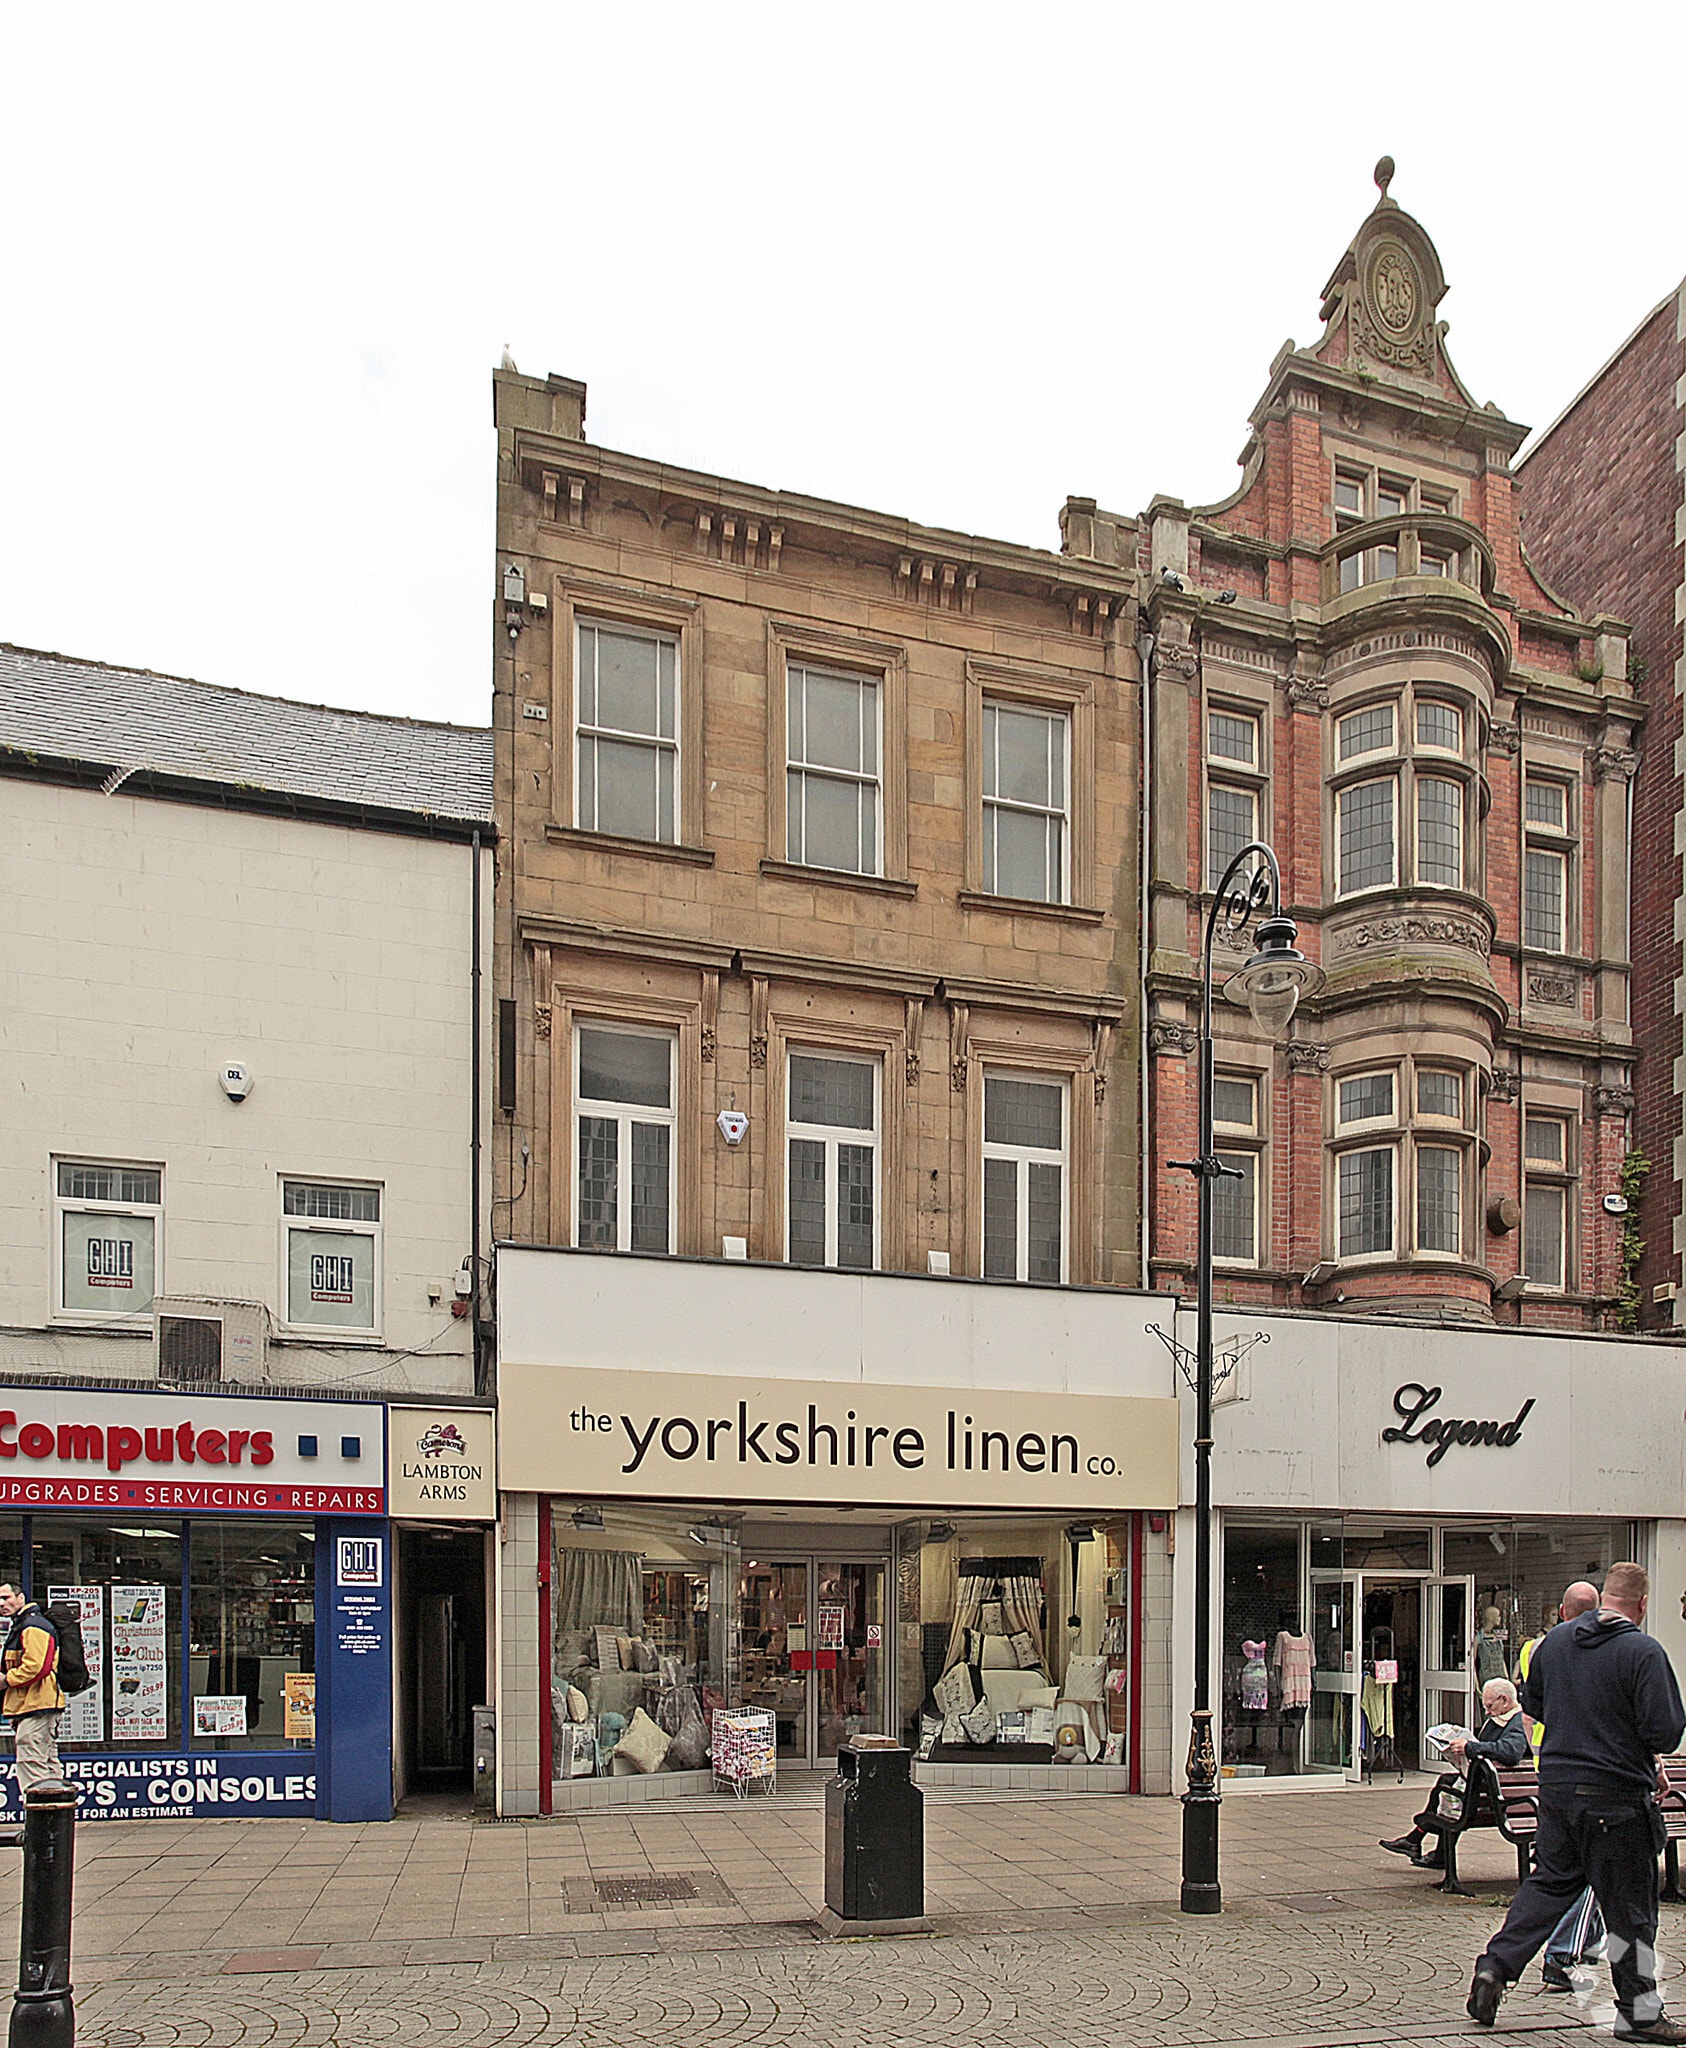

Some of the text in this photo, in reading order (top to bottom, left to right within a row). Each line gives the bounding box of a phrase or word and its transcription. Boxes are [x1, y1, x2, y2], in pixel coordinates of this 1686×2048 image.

[89, 1239, 132, 1276] GHI
[312, 1256, 352, 1291] GHI
[90, 1278, 131, 1287] Computers
[312, 1292, 351, 1302] Computers
[1381, 1383, 1537, 1468] Legend
[0, 1410, 274, 1472] Computers
[569, 1400, 1123, 1476] the yorkshire linen co.
[403, 1463, 482, 1480] LAMBTON
[144, 1486, 268, 1507] SERVICING
[291, 1490, 378, 1509] REPAIRS
[419, 1484, 467, 1500] ARMS
[341, 1542, 377, 1571] GHI
[79, 1607, 101, 1619] 54.99
[113, 1625, 164, 1637] Christmas
[136, 1646, 164, 1661] Club
[88, 1664, 100, 1672] VES
[142, 1681, 164, 1697] £59.99
[194, 1759, 217, 1775] IN
[82, 1808, 108, 1819] FOR
[111, 1807, 129, 1818] AN
[132, 1805, 194, 1817] ESTIMATE
